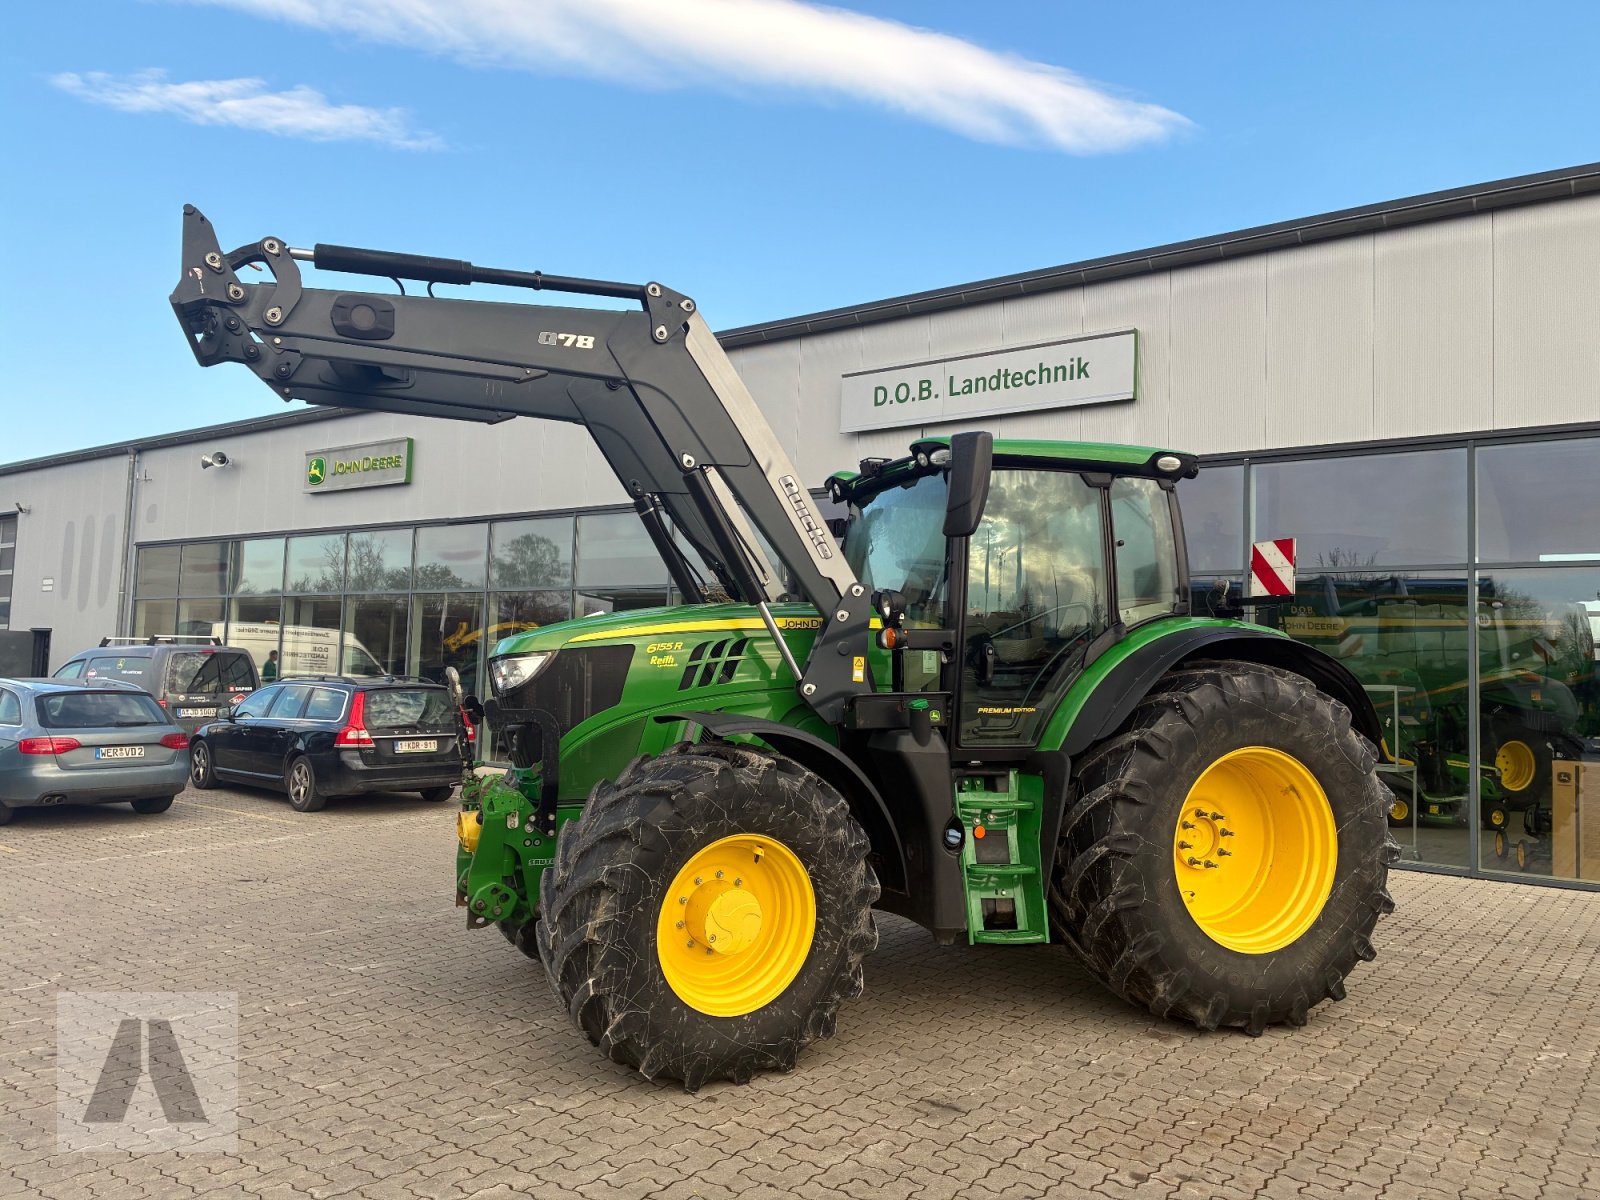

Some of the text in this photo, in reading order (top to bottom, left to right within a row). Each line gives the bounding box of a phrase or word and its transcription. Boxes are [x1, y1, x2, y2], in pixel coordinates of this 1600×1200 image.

[873, 357, 1090, 407] D.O.B. Landtechnik
[331, 455, 403, 476] JOHN DEERE
[782, 619, 810, 628] JOHN
[1308, 622, 1340, 631] DEERE
[646, 642, 674, 654] 6155
[101, 748, 119, 758] WER
[125, 747, 137, 757] VD
